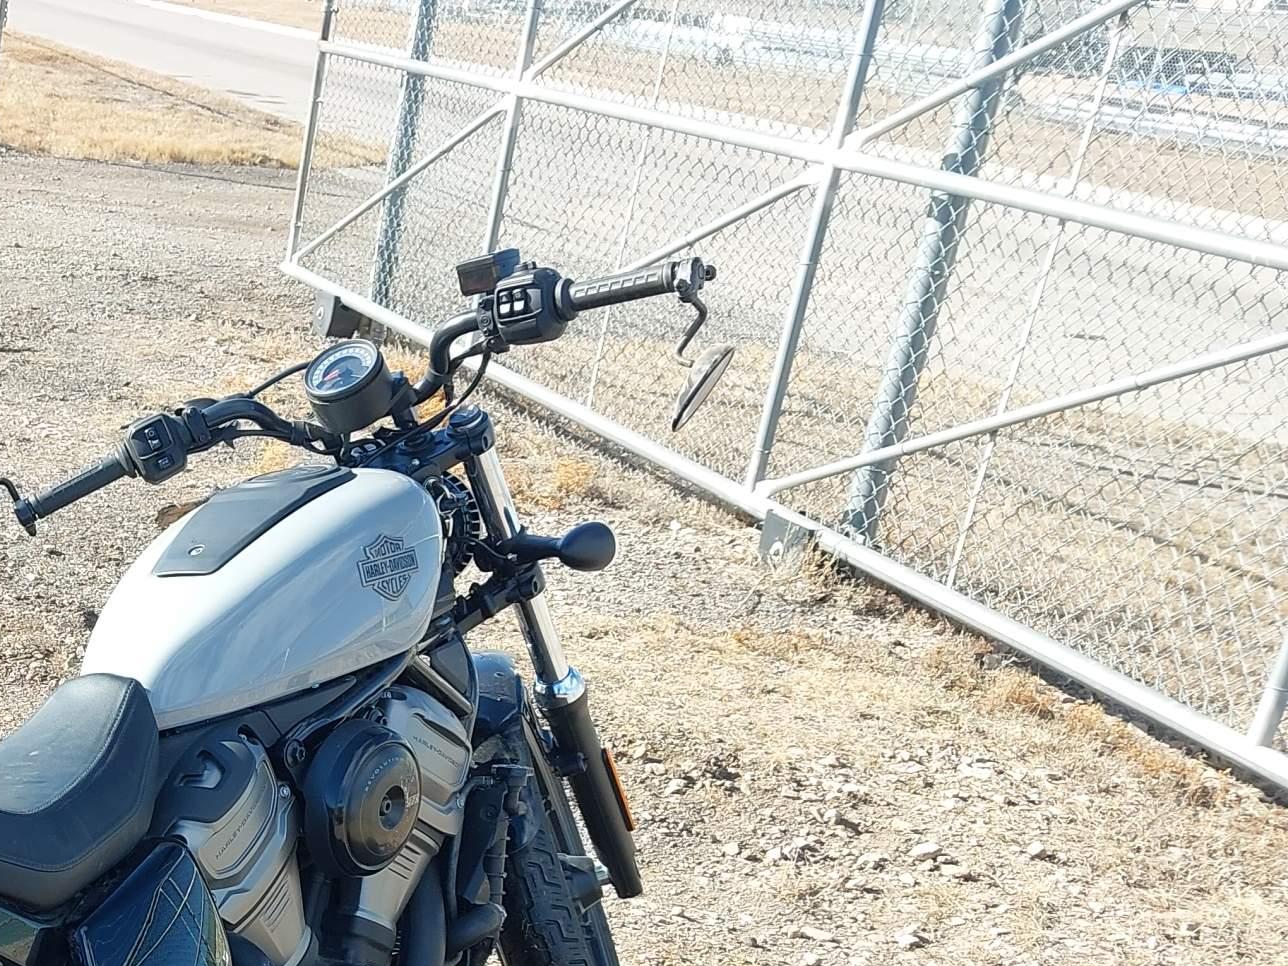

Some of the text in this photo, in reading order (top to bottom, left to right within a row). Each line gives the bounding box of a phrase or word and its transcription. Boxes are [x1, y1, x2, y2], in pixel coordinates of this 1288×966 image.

[373, 540, 402, 559] MOTOR
[364, 552, 416, 580] HARLEY-DAVIDSON
[380, 574, 409, 594] CYCLES
